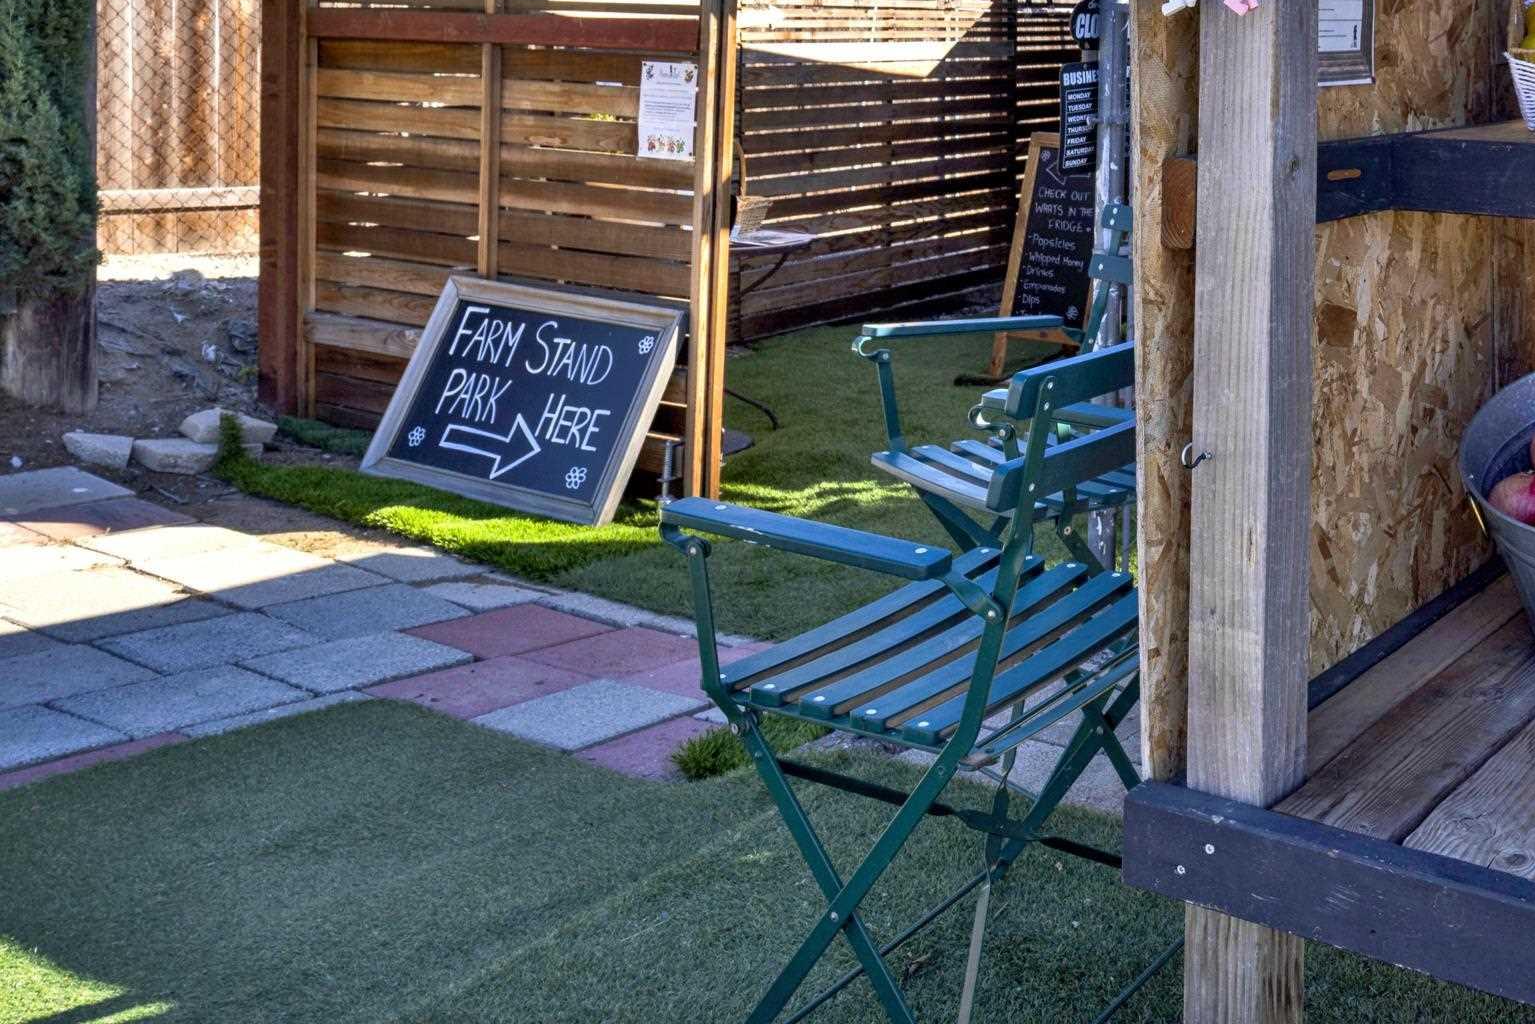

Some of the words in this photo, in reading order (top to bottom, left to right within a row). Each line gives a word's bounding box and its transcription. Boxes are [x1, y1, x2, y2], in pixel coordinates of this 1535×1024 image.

[1063, 70, 1098, 86] BUSINE
[1068, 92, 1091, 100] MONDAY
[1068, 103, 1092, 112] TUESDAY
[1067, 136, 1087, 145] FRIDAY
[1066, 147, 1095, 156] SATURDAY
[1065, 158, 1088, 167] SUNDAY
[1039, 186, 1068, 199] CHECK
[1071, 191, 1089, 201] OUT
[1080, 207, 1094, 216] THE
[449, 306, 525, 367] FARM
[525, 320, 613, 385] STAND
[435, 368, 512, 423] PARK
[534, 393, 611, 451] HERE
